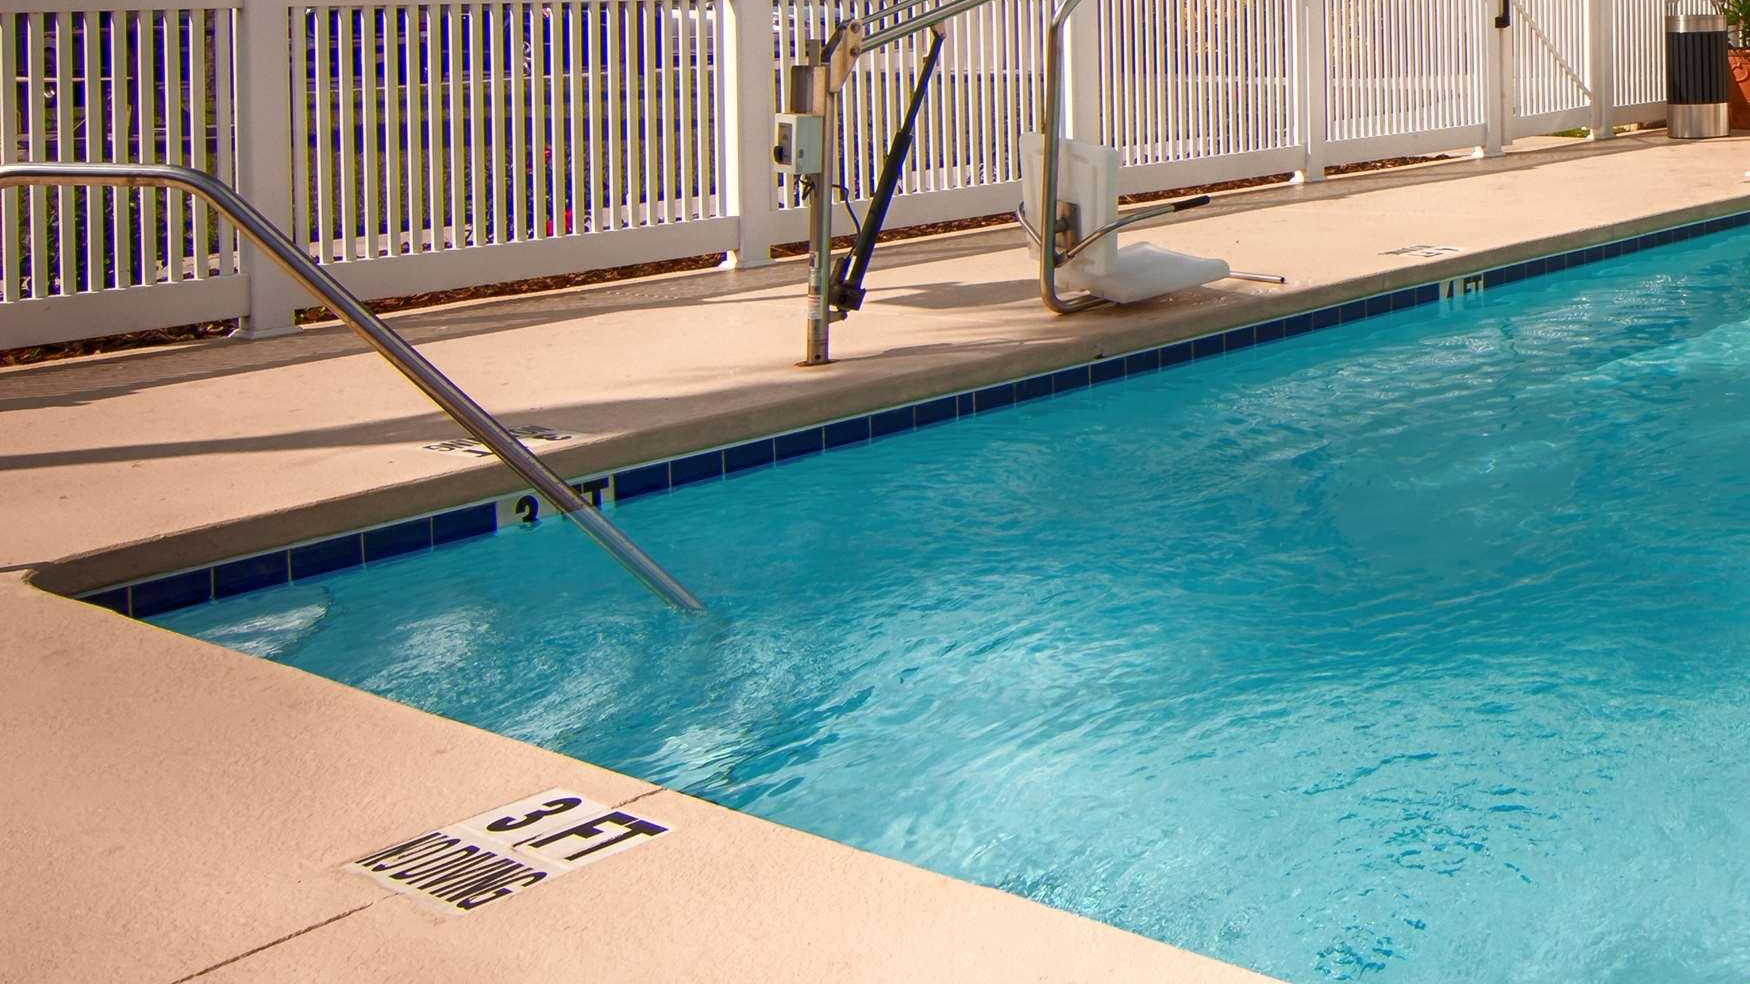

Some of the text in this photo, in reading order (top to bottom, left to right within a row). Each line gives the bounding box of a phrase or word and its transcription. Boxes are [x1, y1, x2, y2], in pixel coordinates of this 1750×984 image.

[486, 797, 670, 862] 3 FT
[353, 831, 549, 911] NO DIVING
